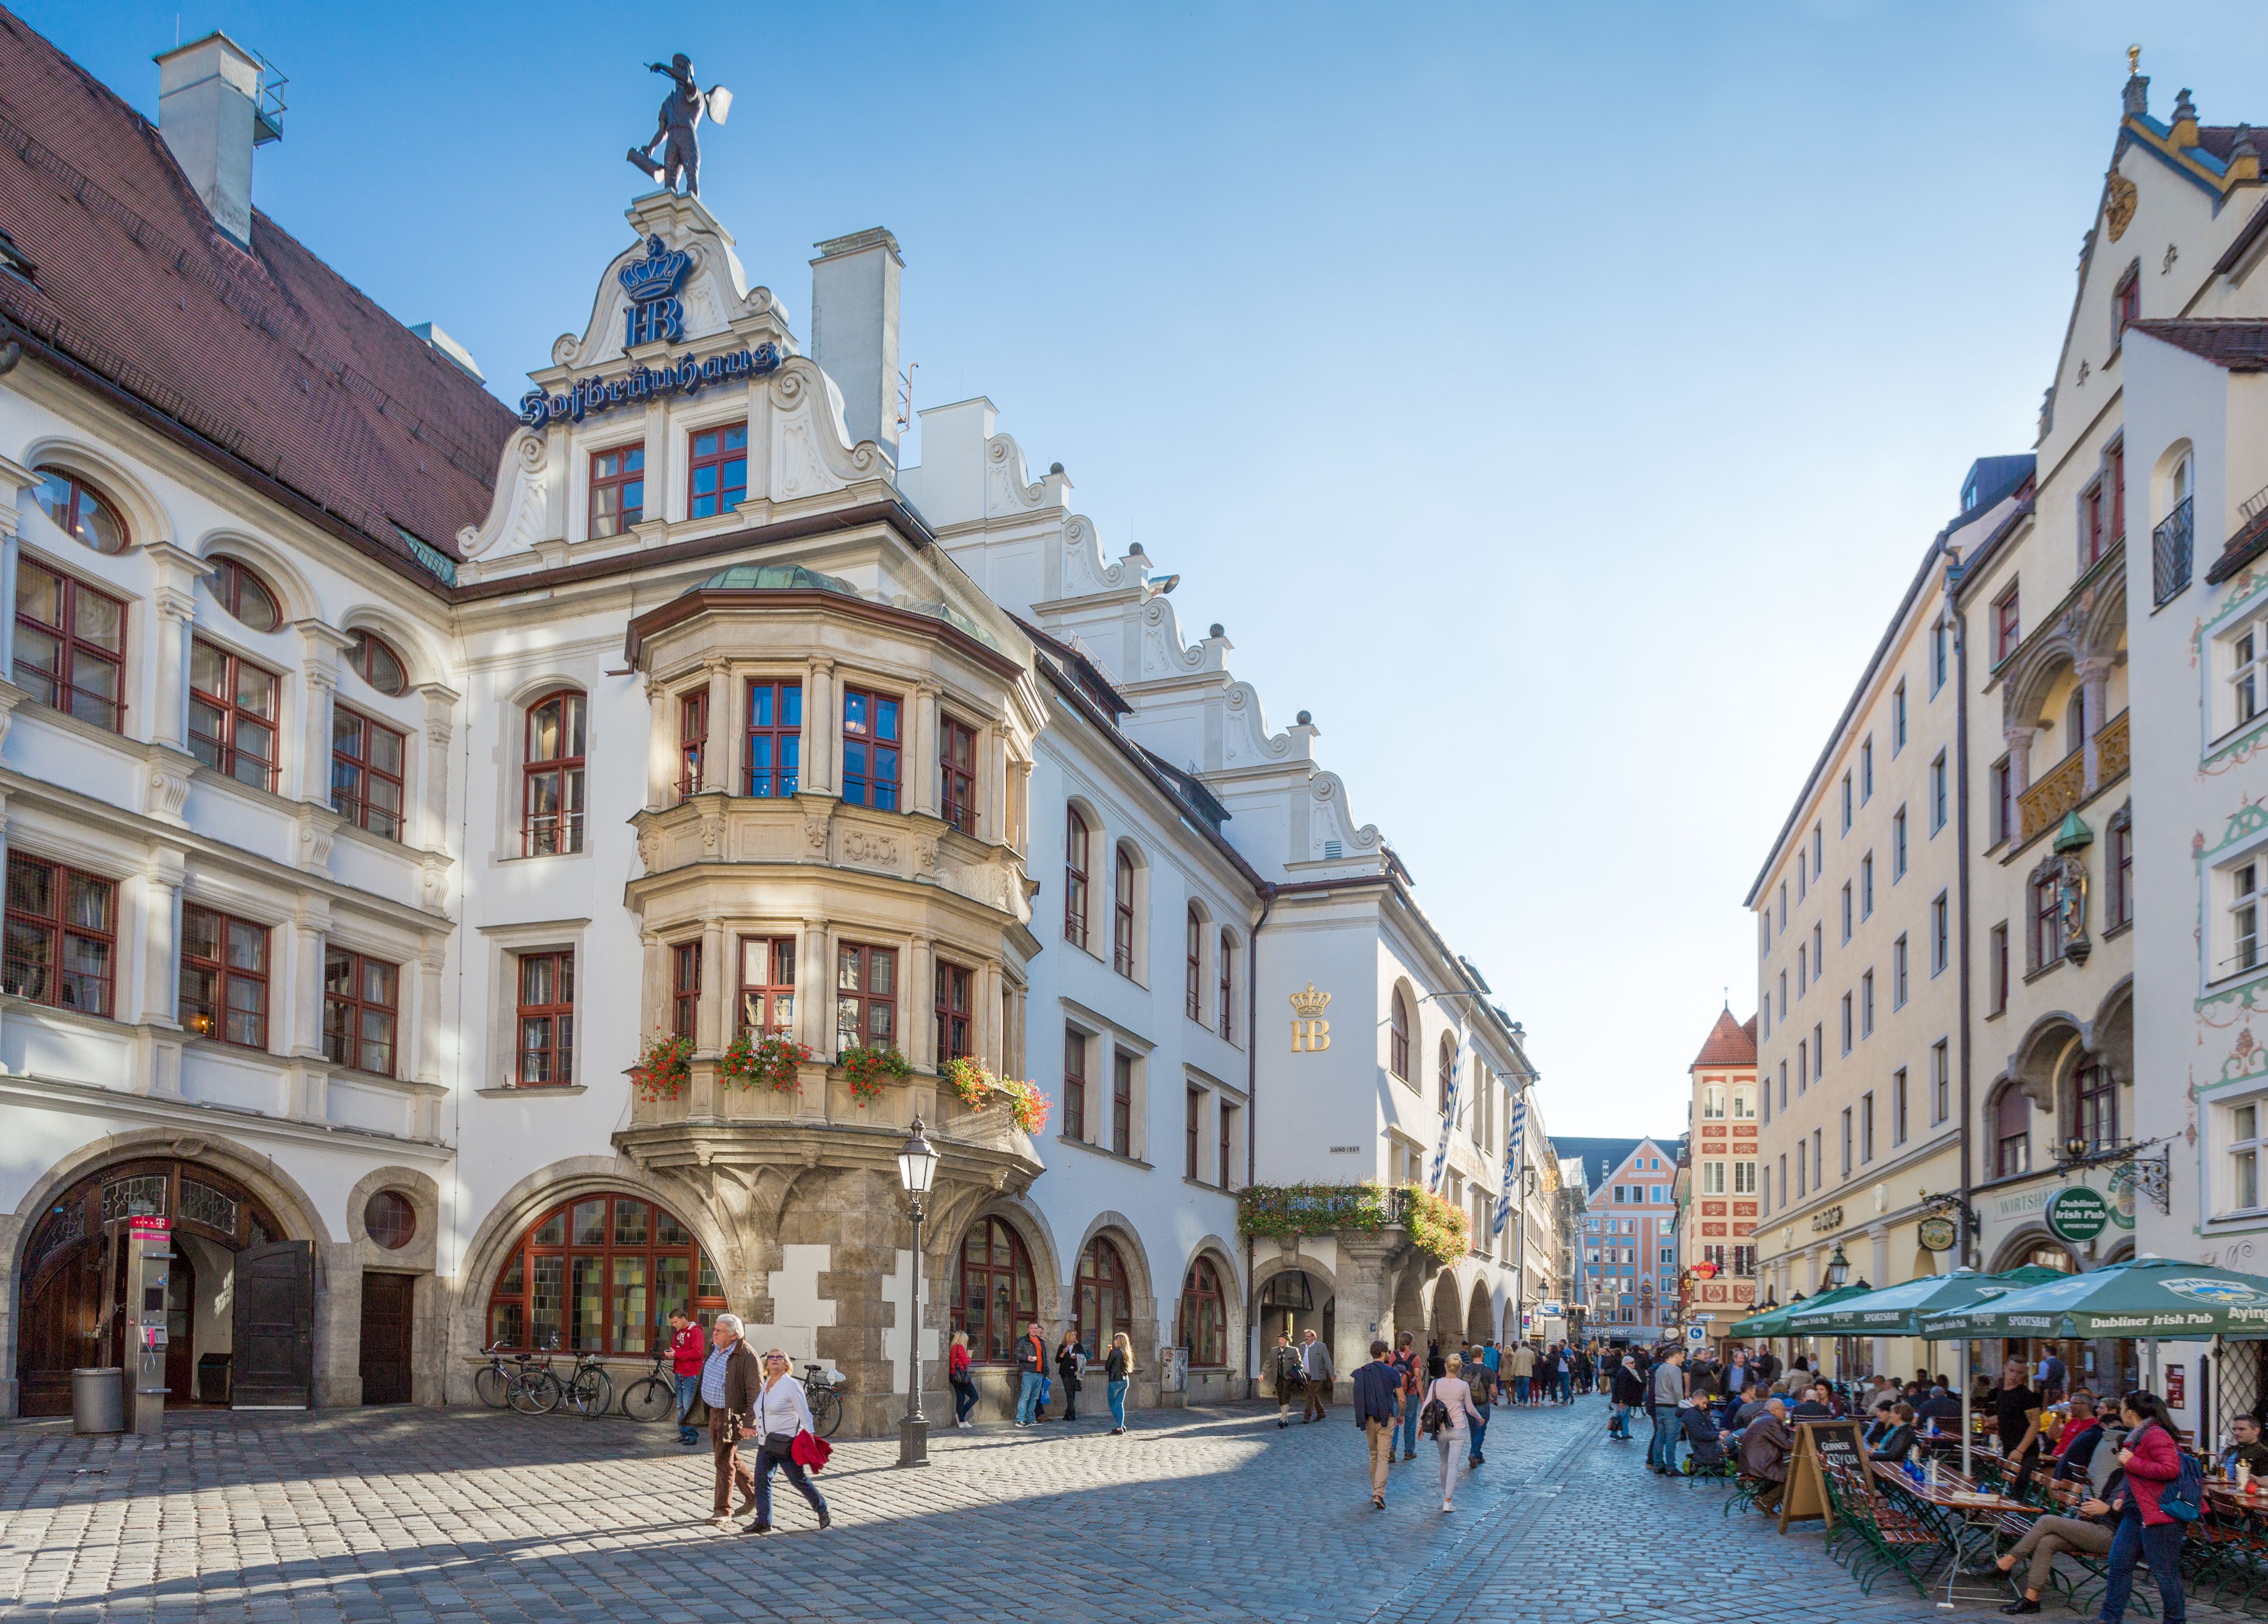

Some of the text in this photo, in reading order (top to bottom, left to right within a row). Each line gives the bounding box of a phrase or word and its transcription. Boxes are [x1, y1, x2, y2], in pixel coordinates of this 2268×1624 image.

[623, 296, 684, 350] HB
[518, 341, 780, 428] Hofbräuhaus
[1291, 1019, 1331, 1052] HB
[1542, 1179, 1557, 1191] HB
[2000, 1190, 2052, 1214] WIRTSHA
[2060, 1199, 2102, 1208] Dubliner
[2055, 1210, 2106, 1219] Irish Pub
[2167, 1279, 2244, 1288] Ayinger
[1863, 1312, 1900, 1322] SPORTSBAR
[1956, 1319, 1967, 1327] Pub
[2008, 1315, 2051, 1328] SPORTSBAR
[2090, 1313, 2214, 1328] Dubliner Irish Pub
[1589, 1327, 1629, 1336] böhmler
[1821, 1441, 1850, 1451] GUINNESS
